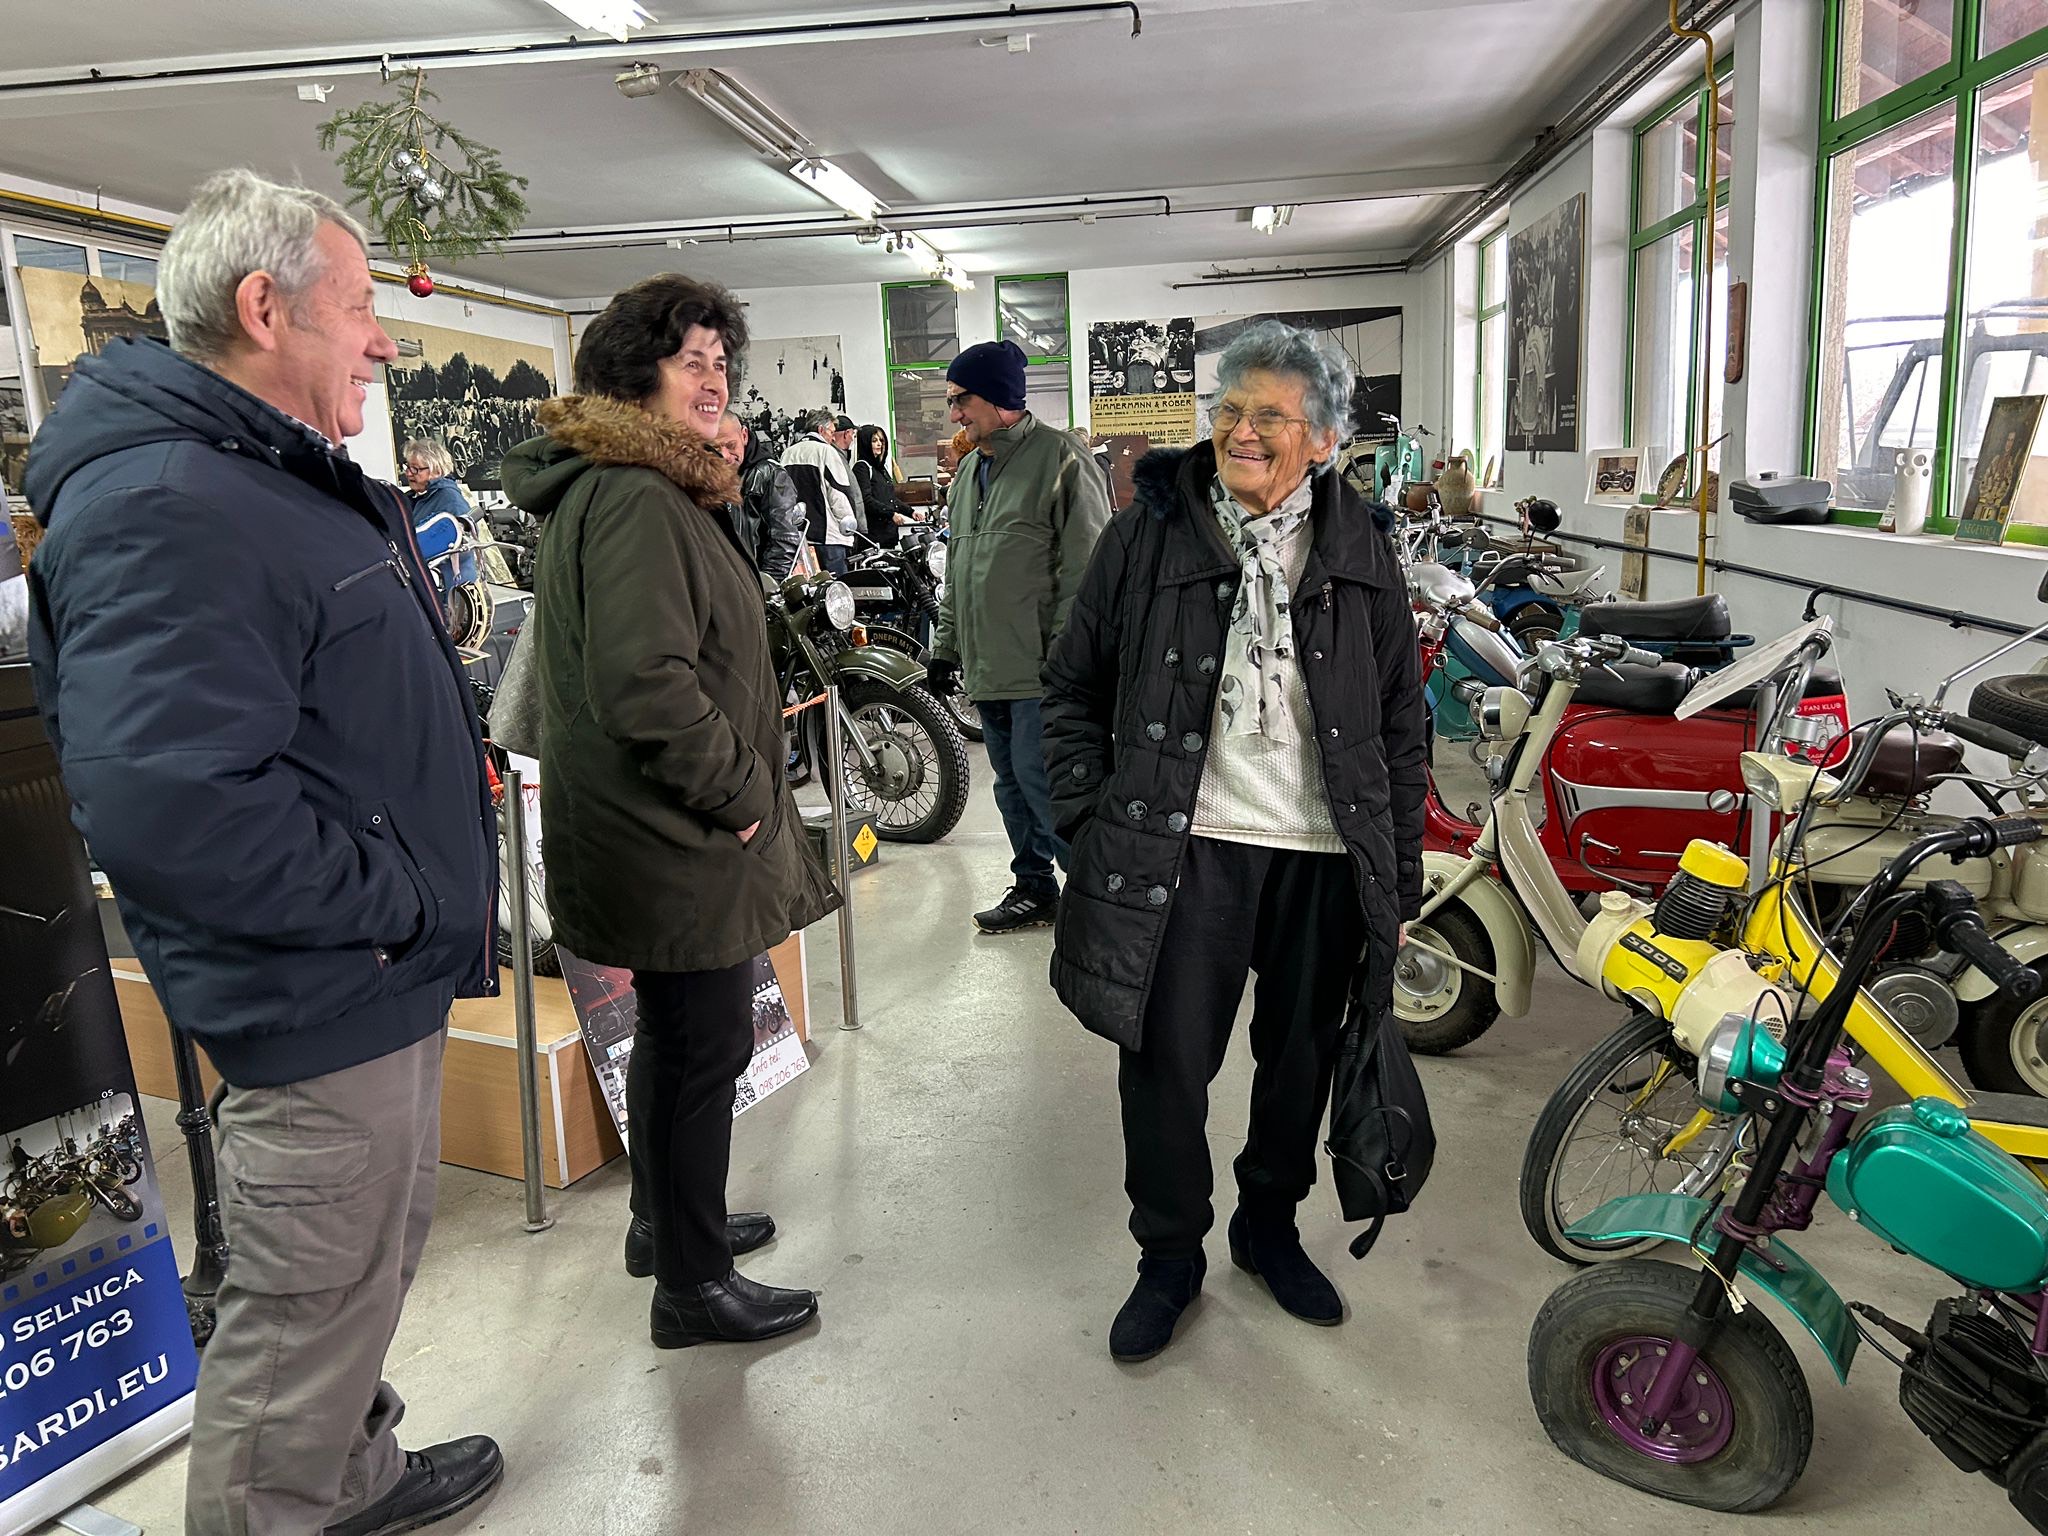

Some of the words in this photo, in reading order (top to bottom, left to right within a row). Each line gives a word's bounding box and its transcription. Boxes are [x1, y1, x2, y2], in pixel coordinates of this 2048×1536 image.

[1095, 401, 1152, 411] ZIMMERMANN
[873, 632, 898, 644] DNEPR
[1803, 704, 1820, 712] FAN
[1822, 702, 1842, 710] KLUB
[751, 1056, 768, 1077] Info
[768, 1047, 781, 1065] tel:
[758, 1077, 774, 1096] 098
[774, 1065, 791, 1085] 206
[791, 1056, 807, 1074] 763
[12, 1267, 145, 1342] SELNICA
[61, 1308, 135, 1362] 763
